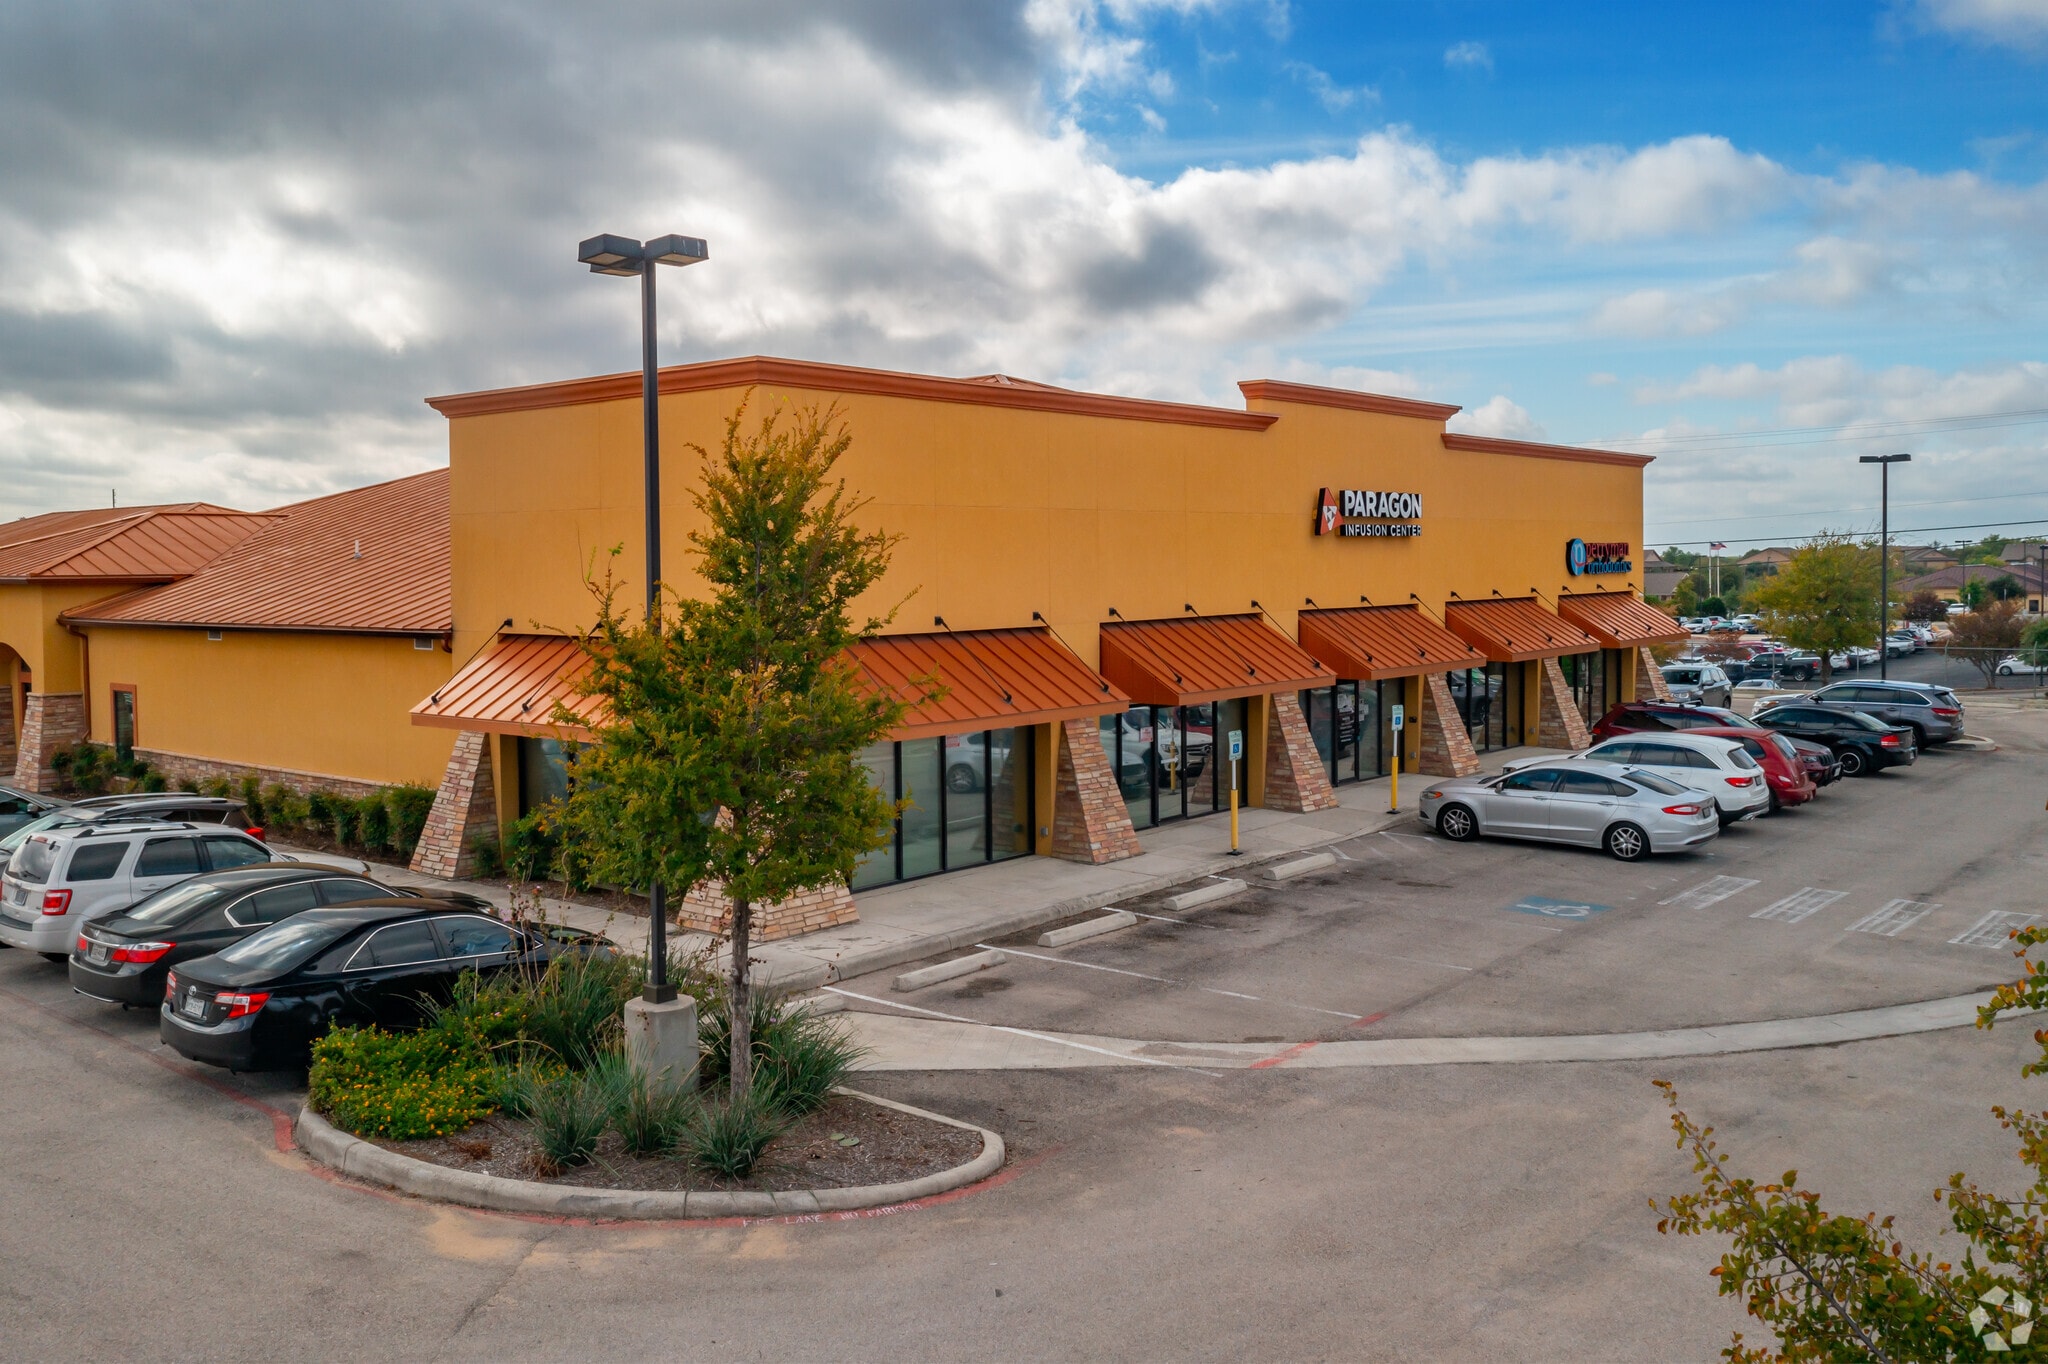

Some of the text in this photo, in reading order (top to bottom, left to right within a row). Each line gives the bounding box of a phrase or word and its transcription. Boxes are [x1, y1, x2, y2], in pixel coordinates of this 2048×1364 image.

[1344, 490, 1422, 518] PARAGON
[1345, 524, 1422, 536] INFUSION CENTER
[785, 1214, 824, 1225] LANE
[840, 1211, 859, 1221] NO
